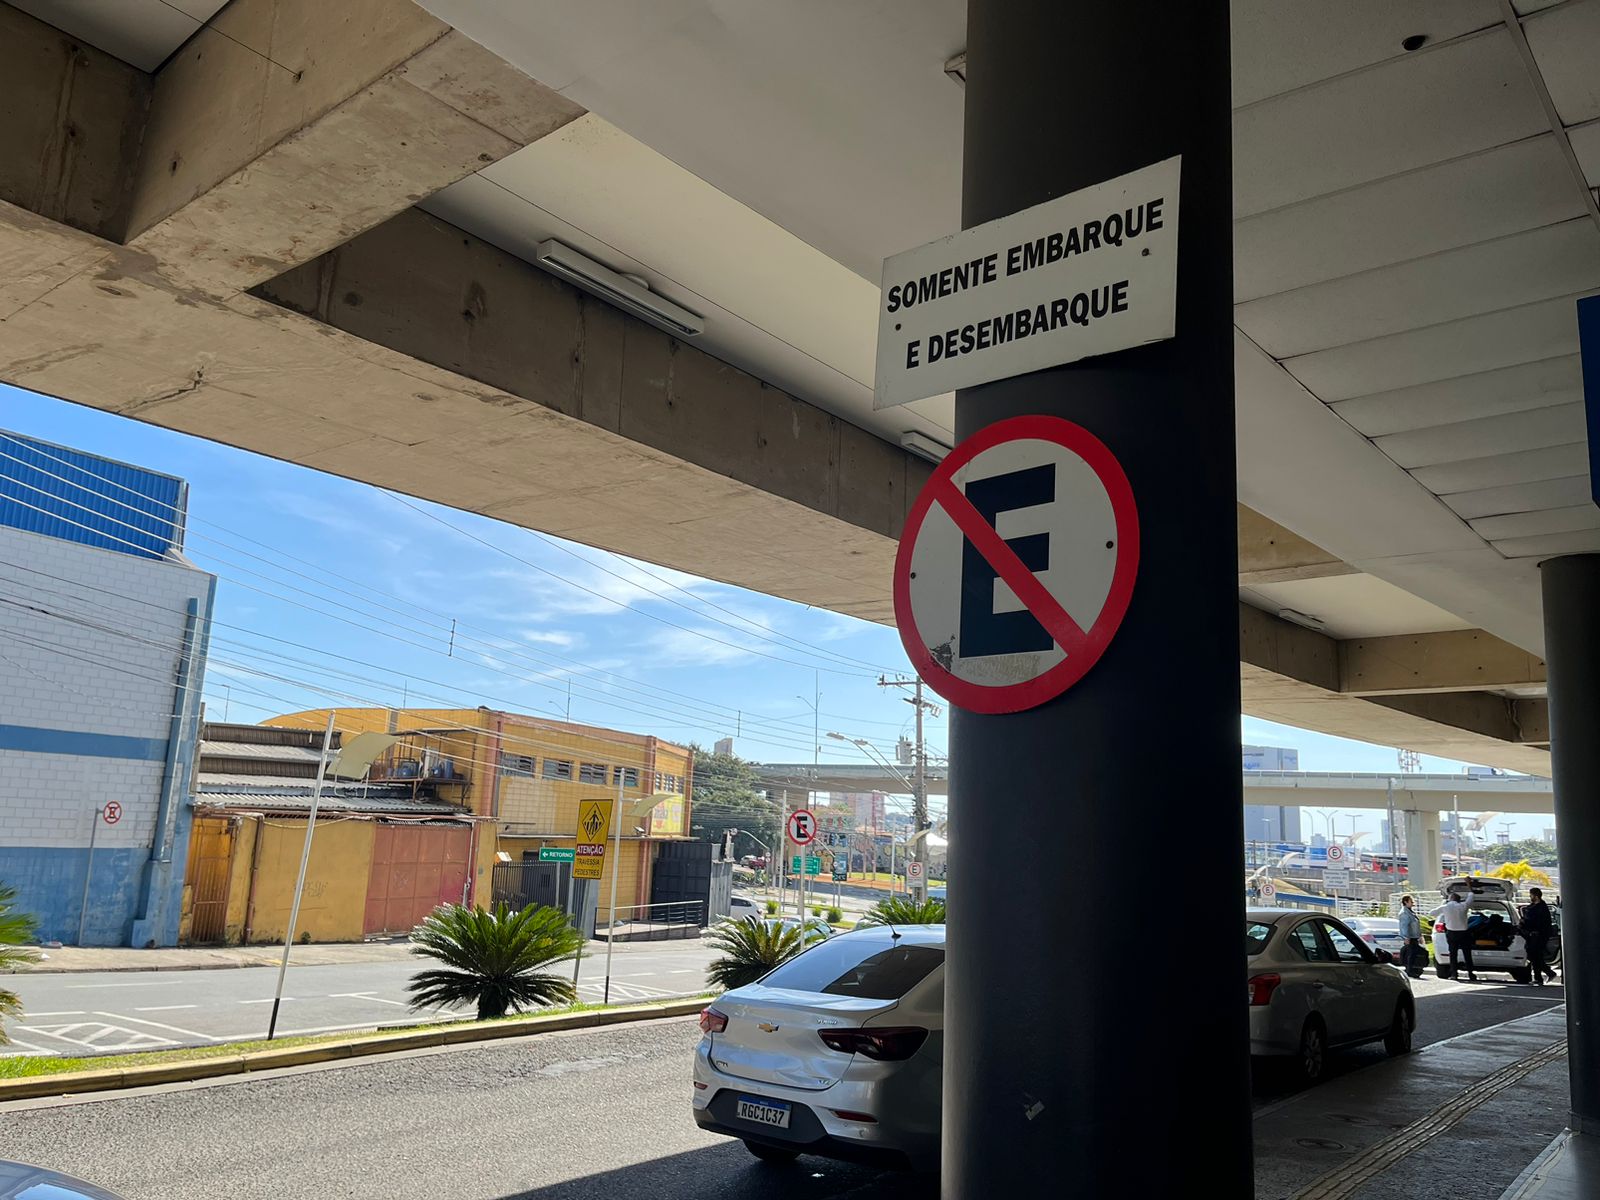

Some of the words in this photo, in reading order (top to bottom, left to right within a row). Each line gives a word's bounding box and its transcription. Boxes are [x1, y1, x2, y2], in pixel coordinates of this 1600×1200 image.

[887, 253, 998, 312] SOMENTE
[1006, 198, 1164, 276] EMBARQUE
[906, 340, 920, 369] E
[928, 280, 1129, 364] DESEMBARQUE
[959, 463, 1056, 658] E
[576, 845, 604, 855] ATENÇÃO
[796, 816, 808, 838] E
[741, 1103, 785, 1125] RGC1C37
